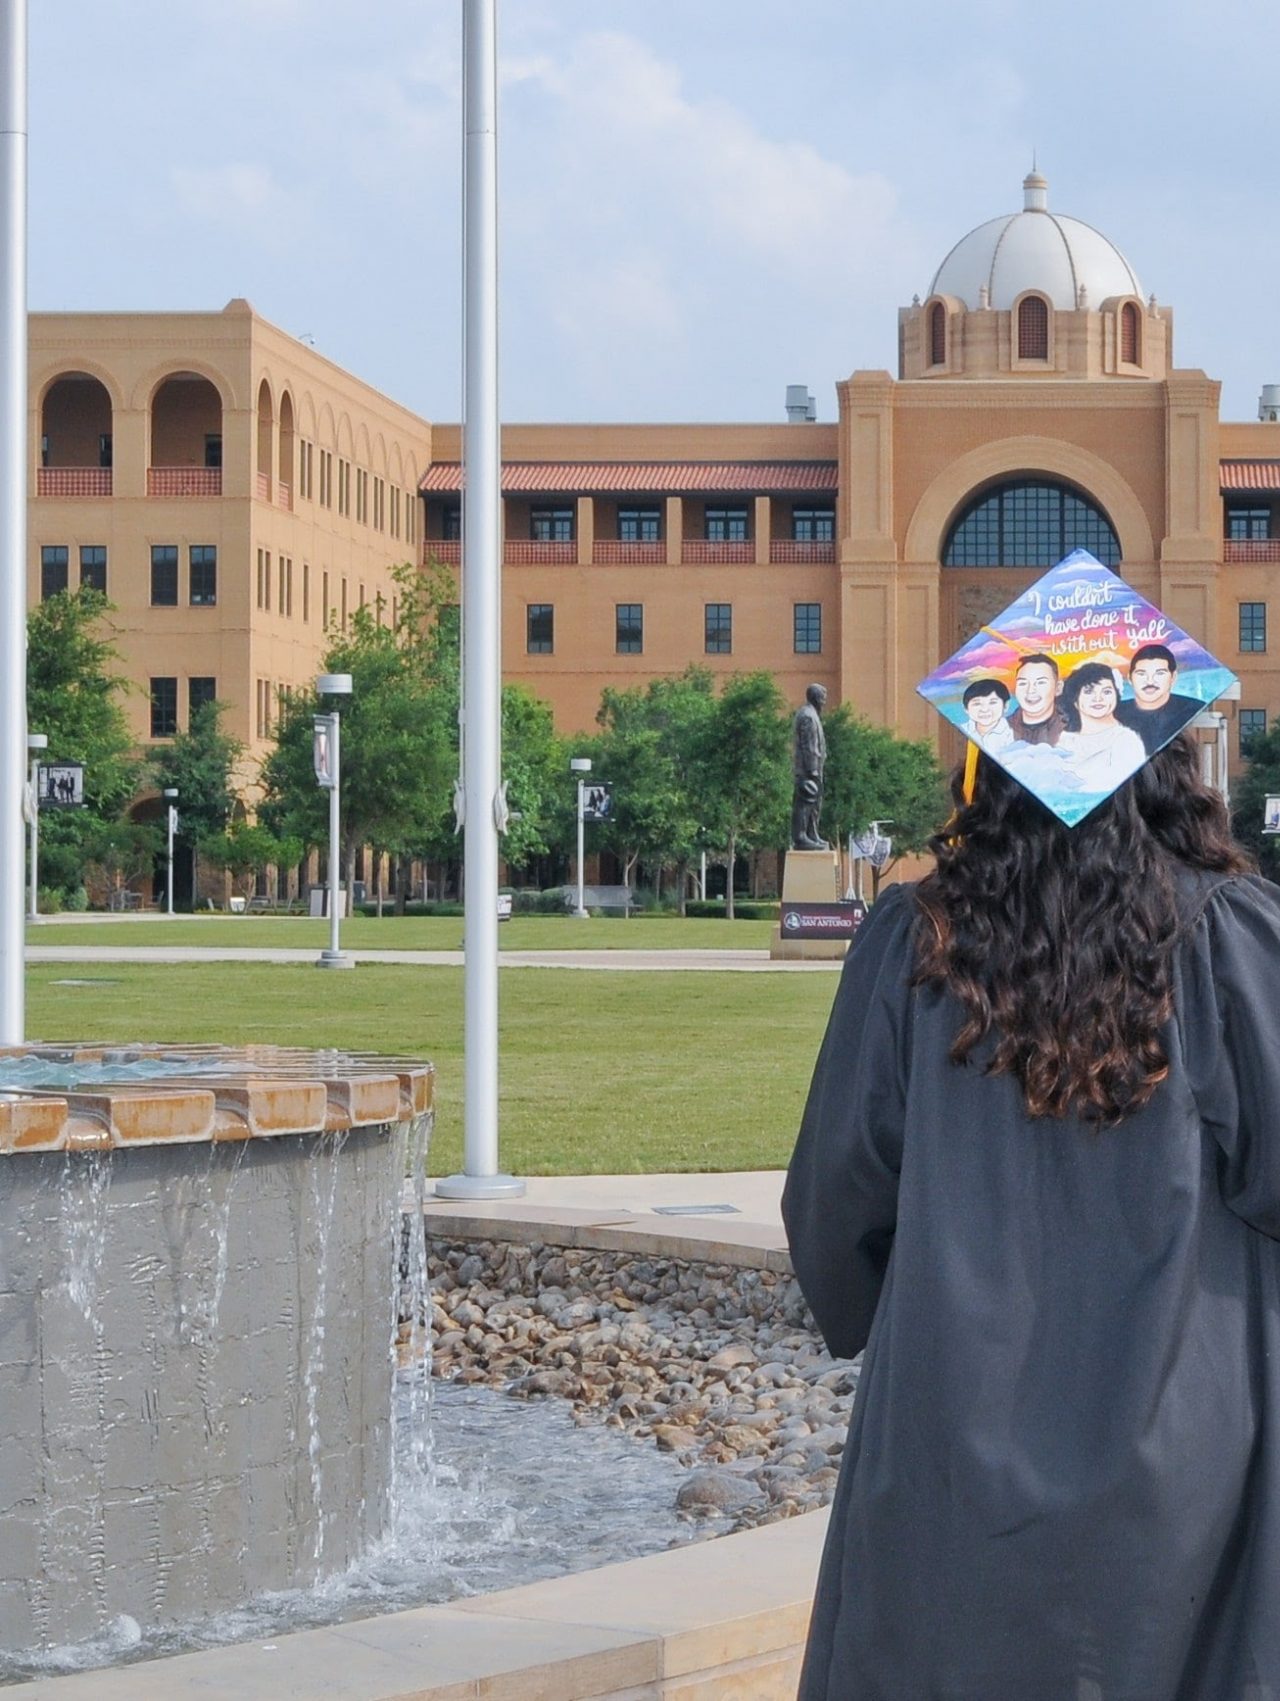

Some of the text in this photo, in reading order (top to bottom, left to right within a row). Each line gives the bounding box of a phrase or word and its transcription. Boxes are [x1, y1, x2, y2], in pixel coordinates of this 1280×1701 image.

[1028, 582, 1114, 617] I couldn't
[1045, 613, 1080, 636] have
[1081, 609, 1120, 630] done
[817, 919, 852, 928] ANTONIO
